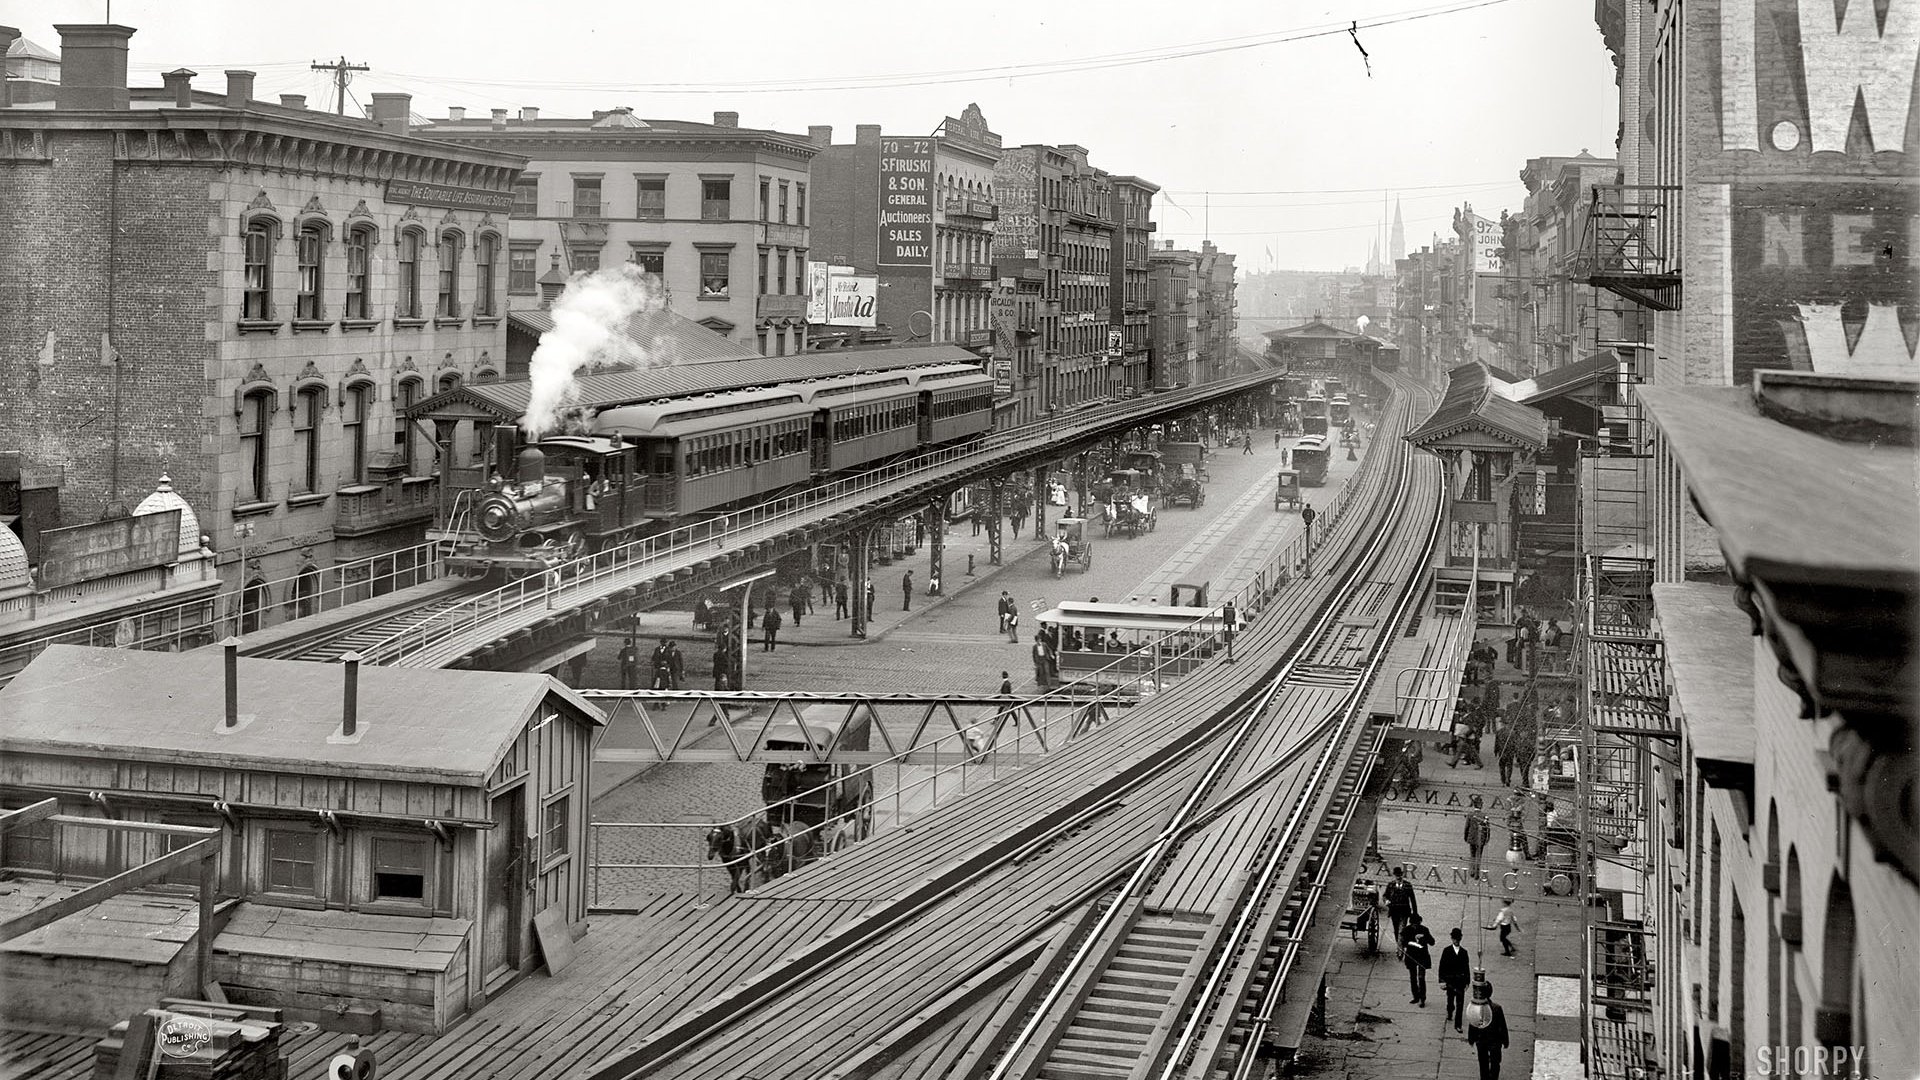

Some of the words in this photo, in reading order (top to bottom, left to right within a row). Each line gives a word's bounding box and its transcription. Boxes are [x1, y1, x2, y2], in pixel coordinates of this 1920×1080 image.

[883, 141, 898, 154] 70
[913, 141, 929, 154] 72
[881, 158, 931, 173] S.FIRUSKI
[888, 176, 898, 191] &
[888, 194, 928, 206] GENERAL
[889, 229, 922, 242] SALES
